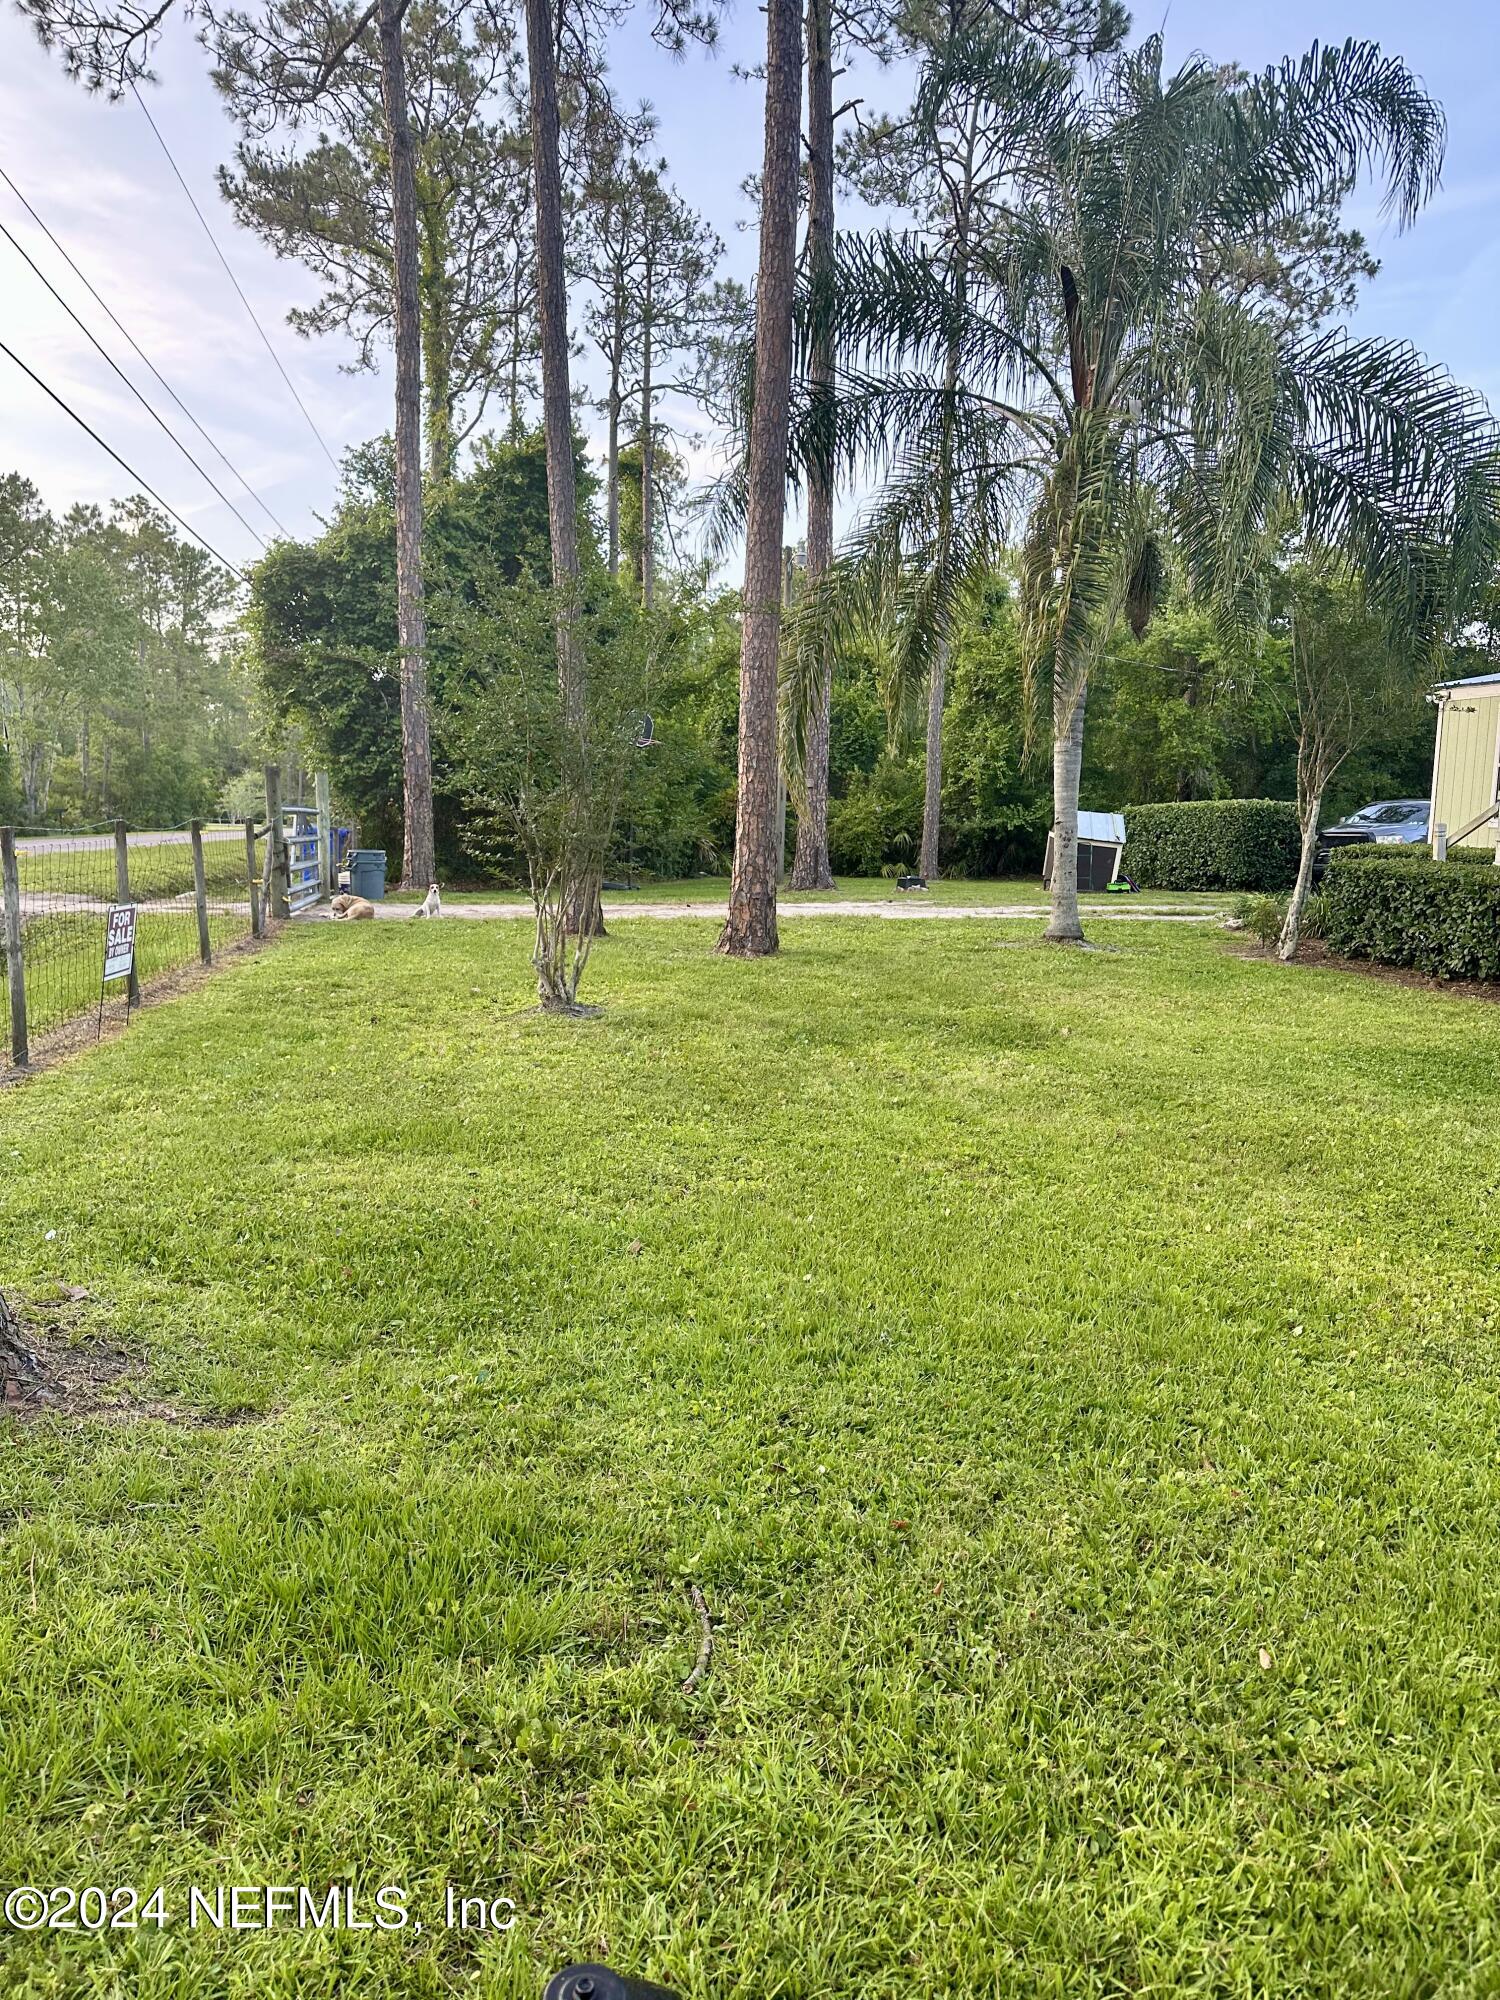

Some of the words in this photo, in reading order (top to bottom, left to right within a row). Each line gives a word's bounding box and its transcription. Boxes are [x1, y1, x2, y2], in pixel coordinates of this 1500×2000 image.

[113, 911, 131, 928] FOR
[108, 926, 133, 946] SALE
[109, 947, 115, 958] BY
[115, 944, 129, 955] OWNER
